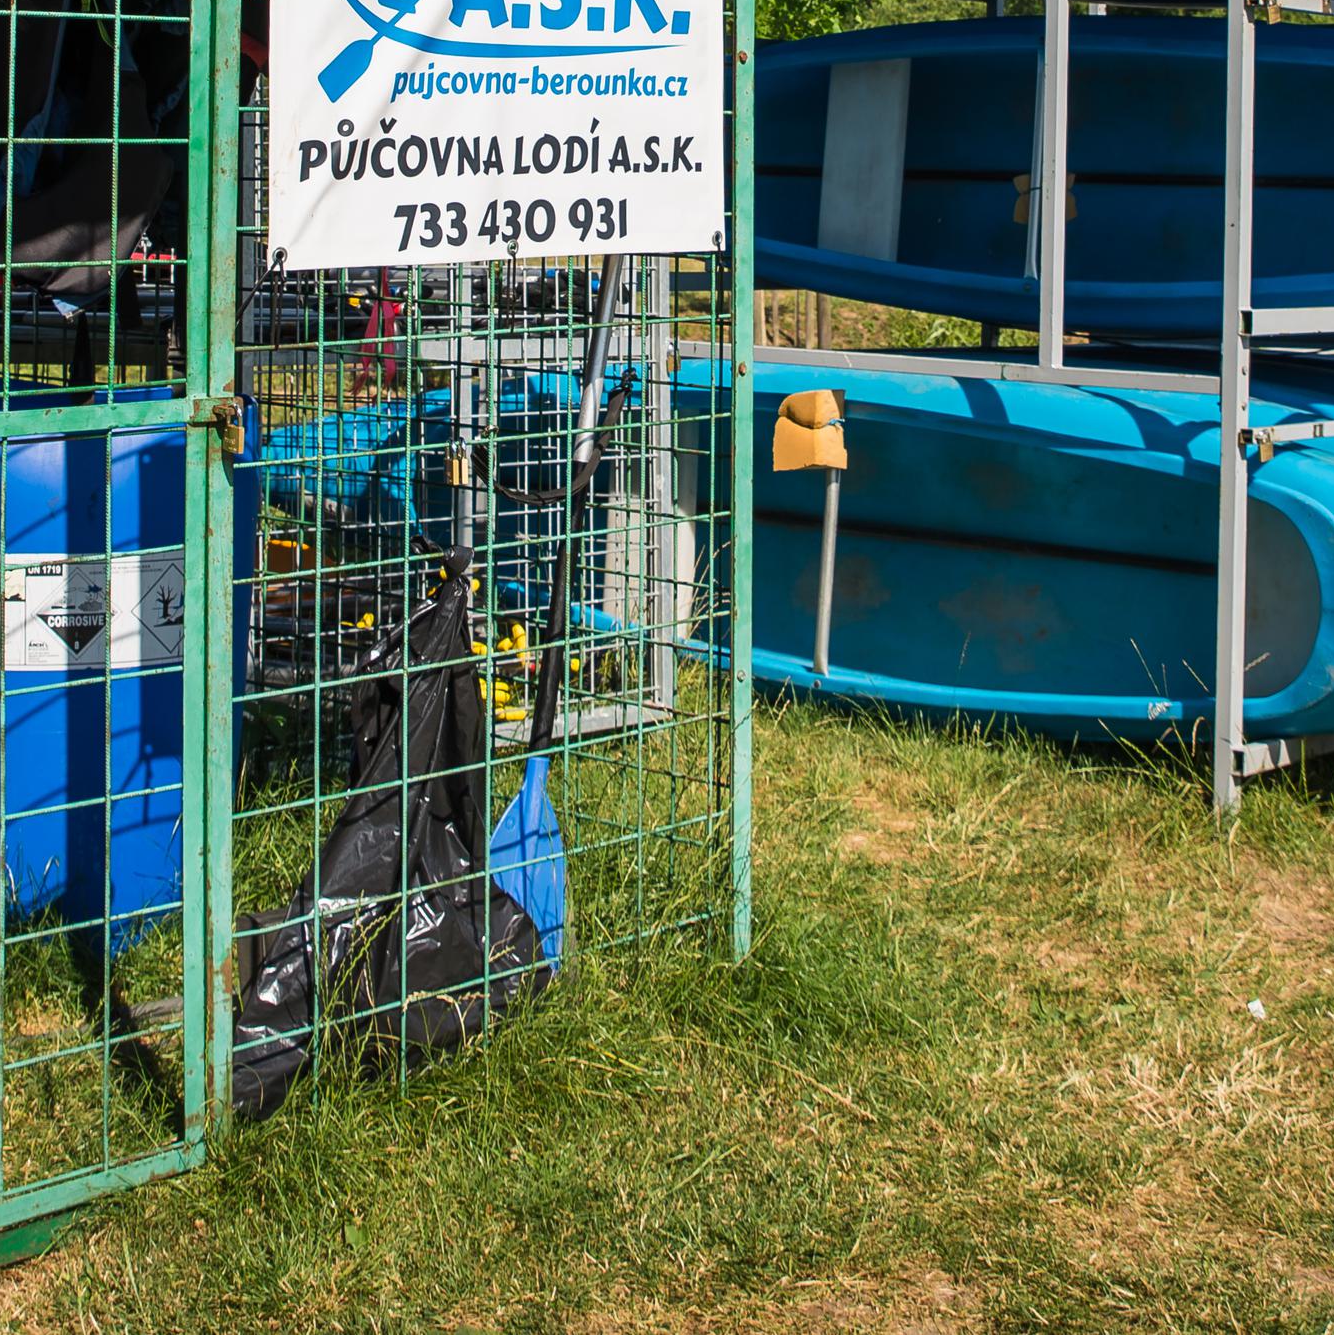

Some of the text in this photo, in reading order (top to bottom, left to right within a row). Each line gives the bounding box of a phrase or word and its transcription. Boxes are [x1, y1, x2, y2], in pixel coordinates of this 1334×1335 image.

[391, 62, 689, 103] pujcovna-berounka.cz
[299, 118, 703, 182] PŮJČOVNA LODÍ A.S.K.
[393, 198, 628, 252] 733 430 931
[42, 565, 61, 574] 1719
[47, 615, 105, 628] CORROSIVE
